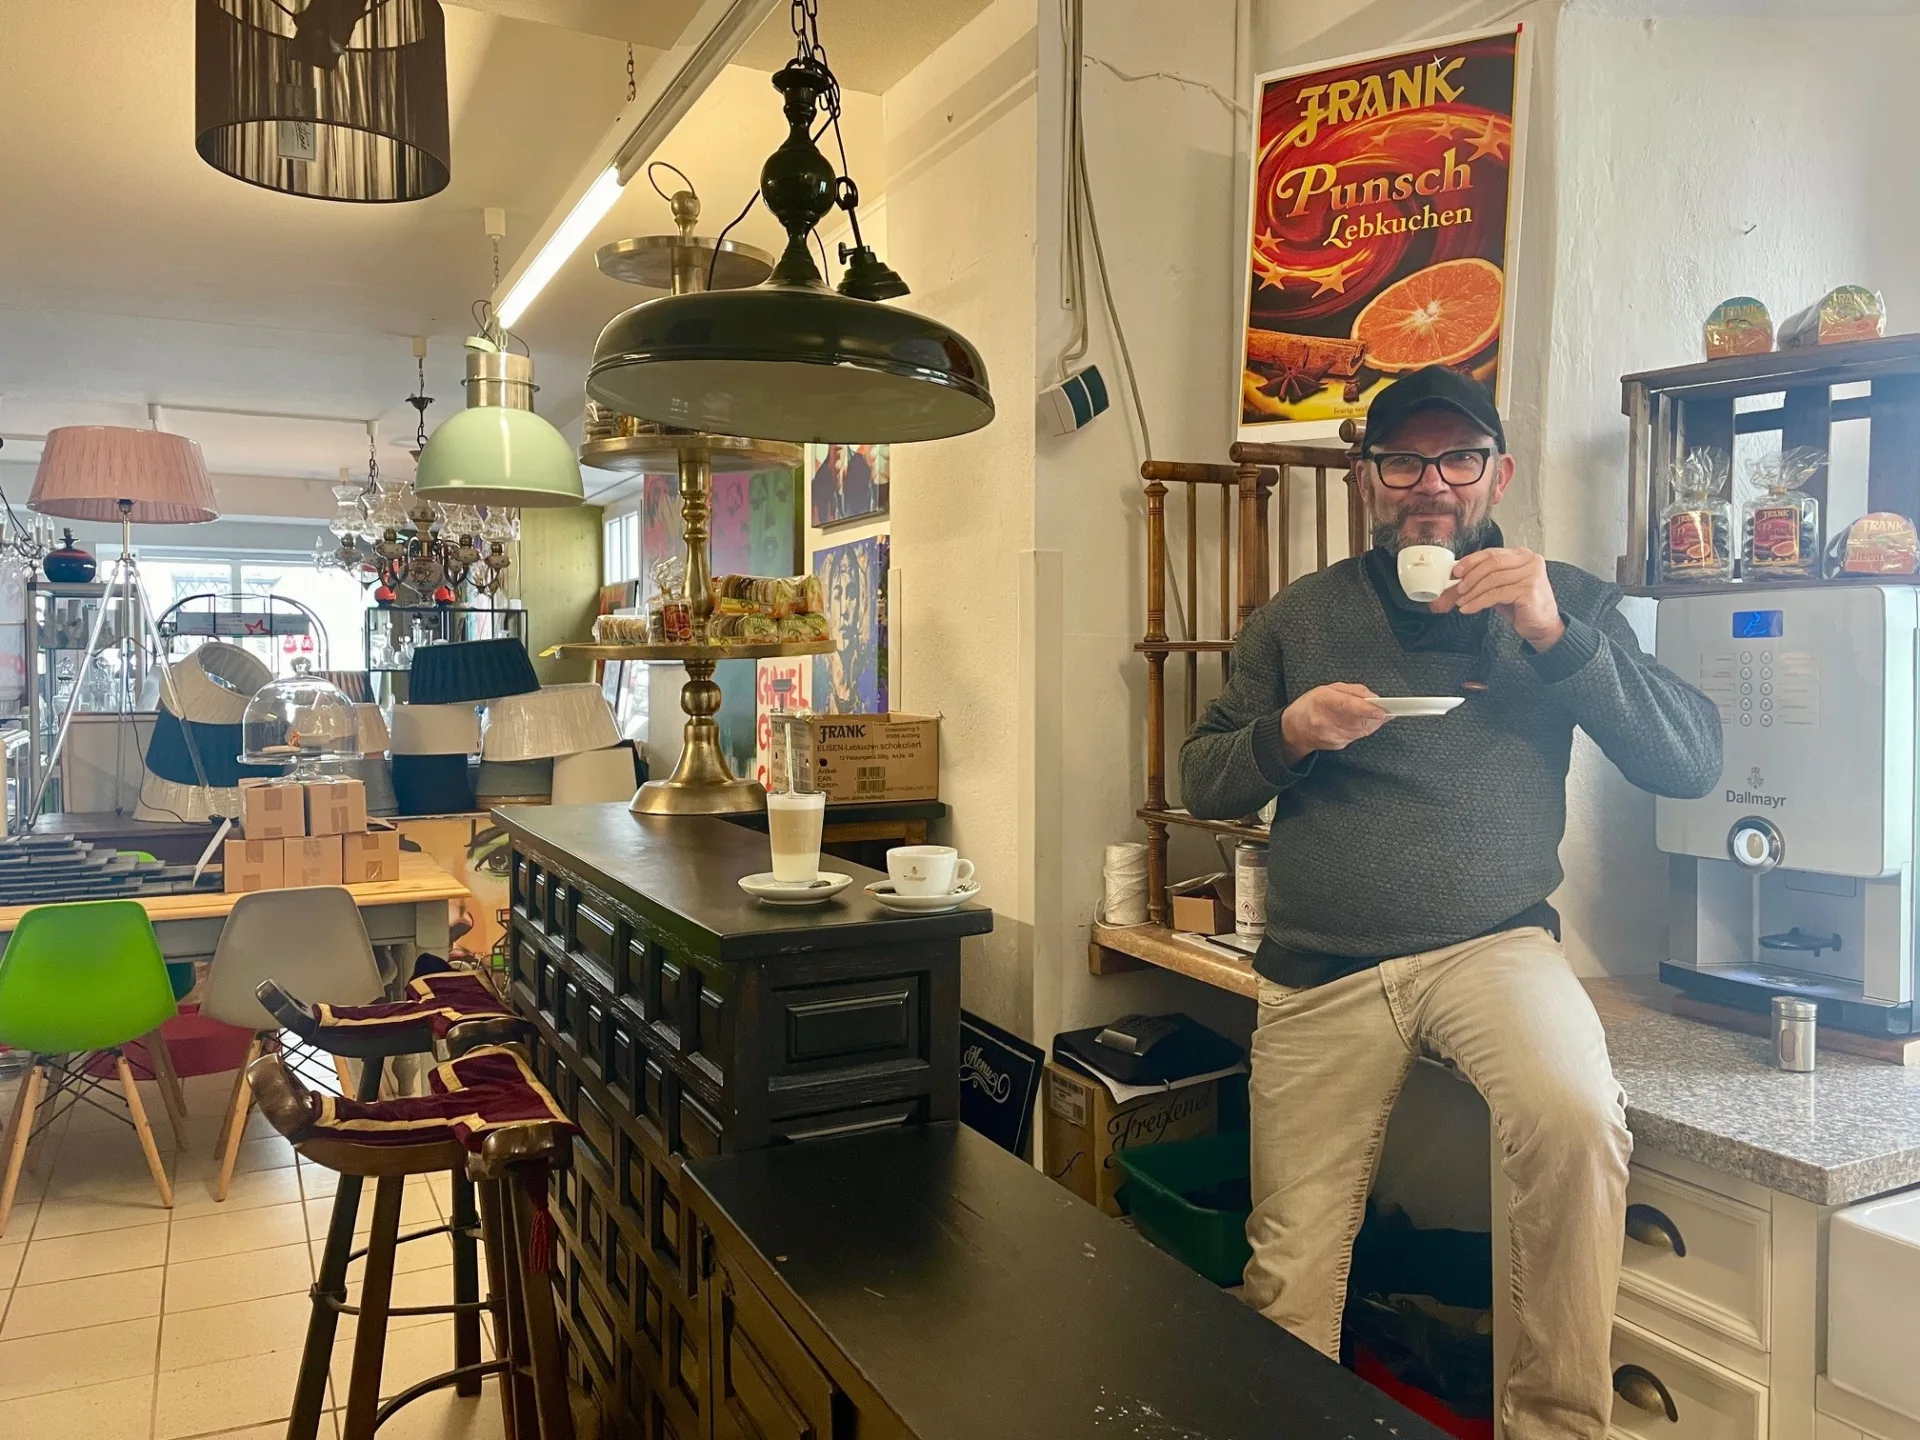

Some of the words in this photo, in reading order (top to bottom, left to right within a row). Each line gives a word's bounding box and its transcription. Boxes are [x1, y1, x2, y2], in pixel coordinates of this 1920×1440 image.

[1296, 56, 1466, 148] FRANK
[1277, 147, 1473, 218] Punsch
[1322, 204, 1473, 249] Lebkuchen
[1720, 303, 1761, 320] FRANK
[1763, 510, 1790, 520] FRANK
[1864, 520, 1904, 533] FRANK
[818, 724, 867, 743] FRANK
[880, 741, 922, 750] schokoliert
[1726, 790, 1787, 808] Dallmayr
